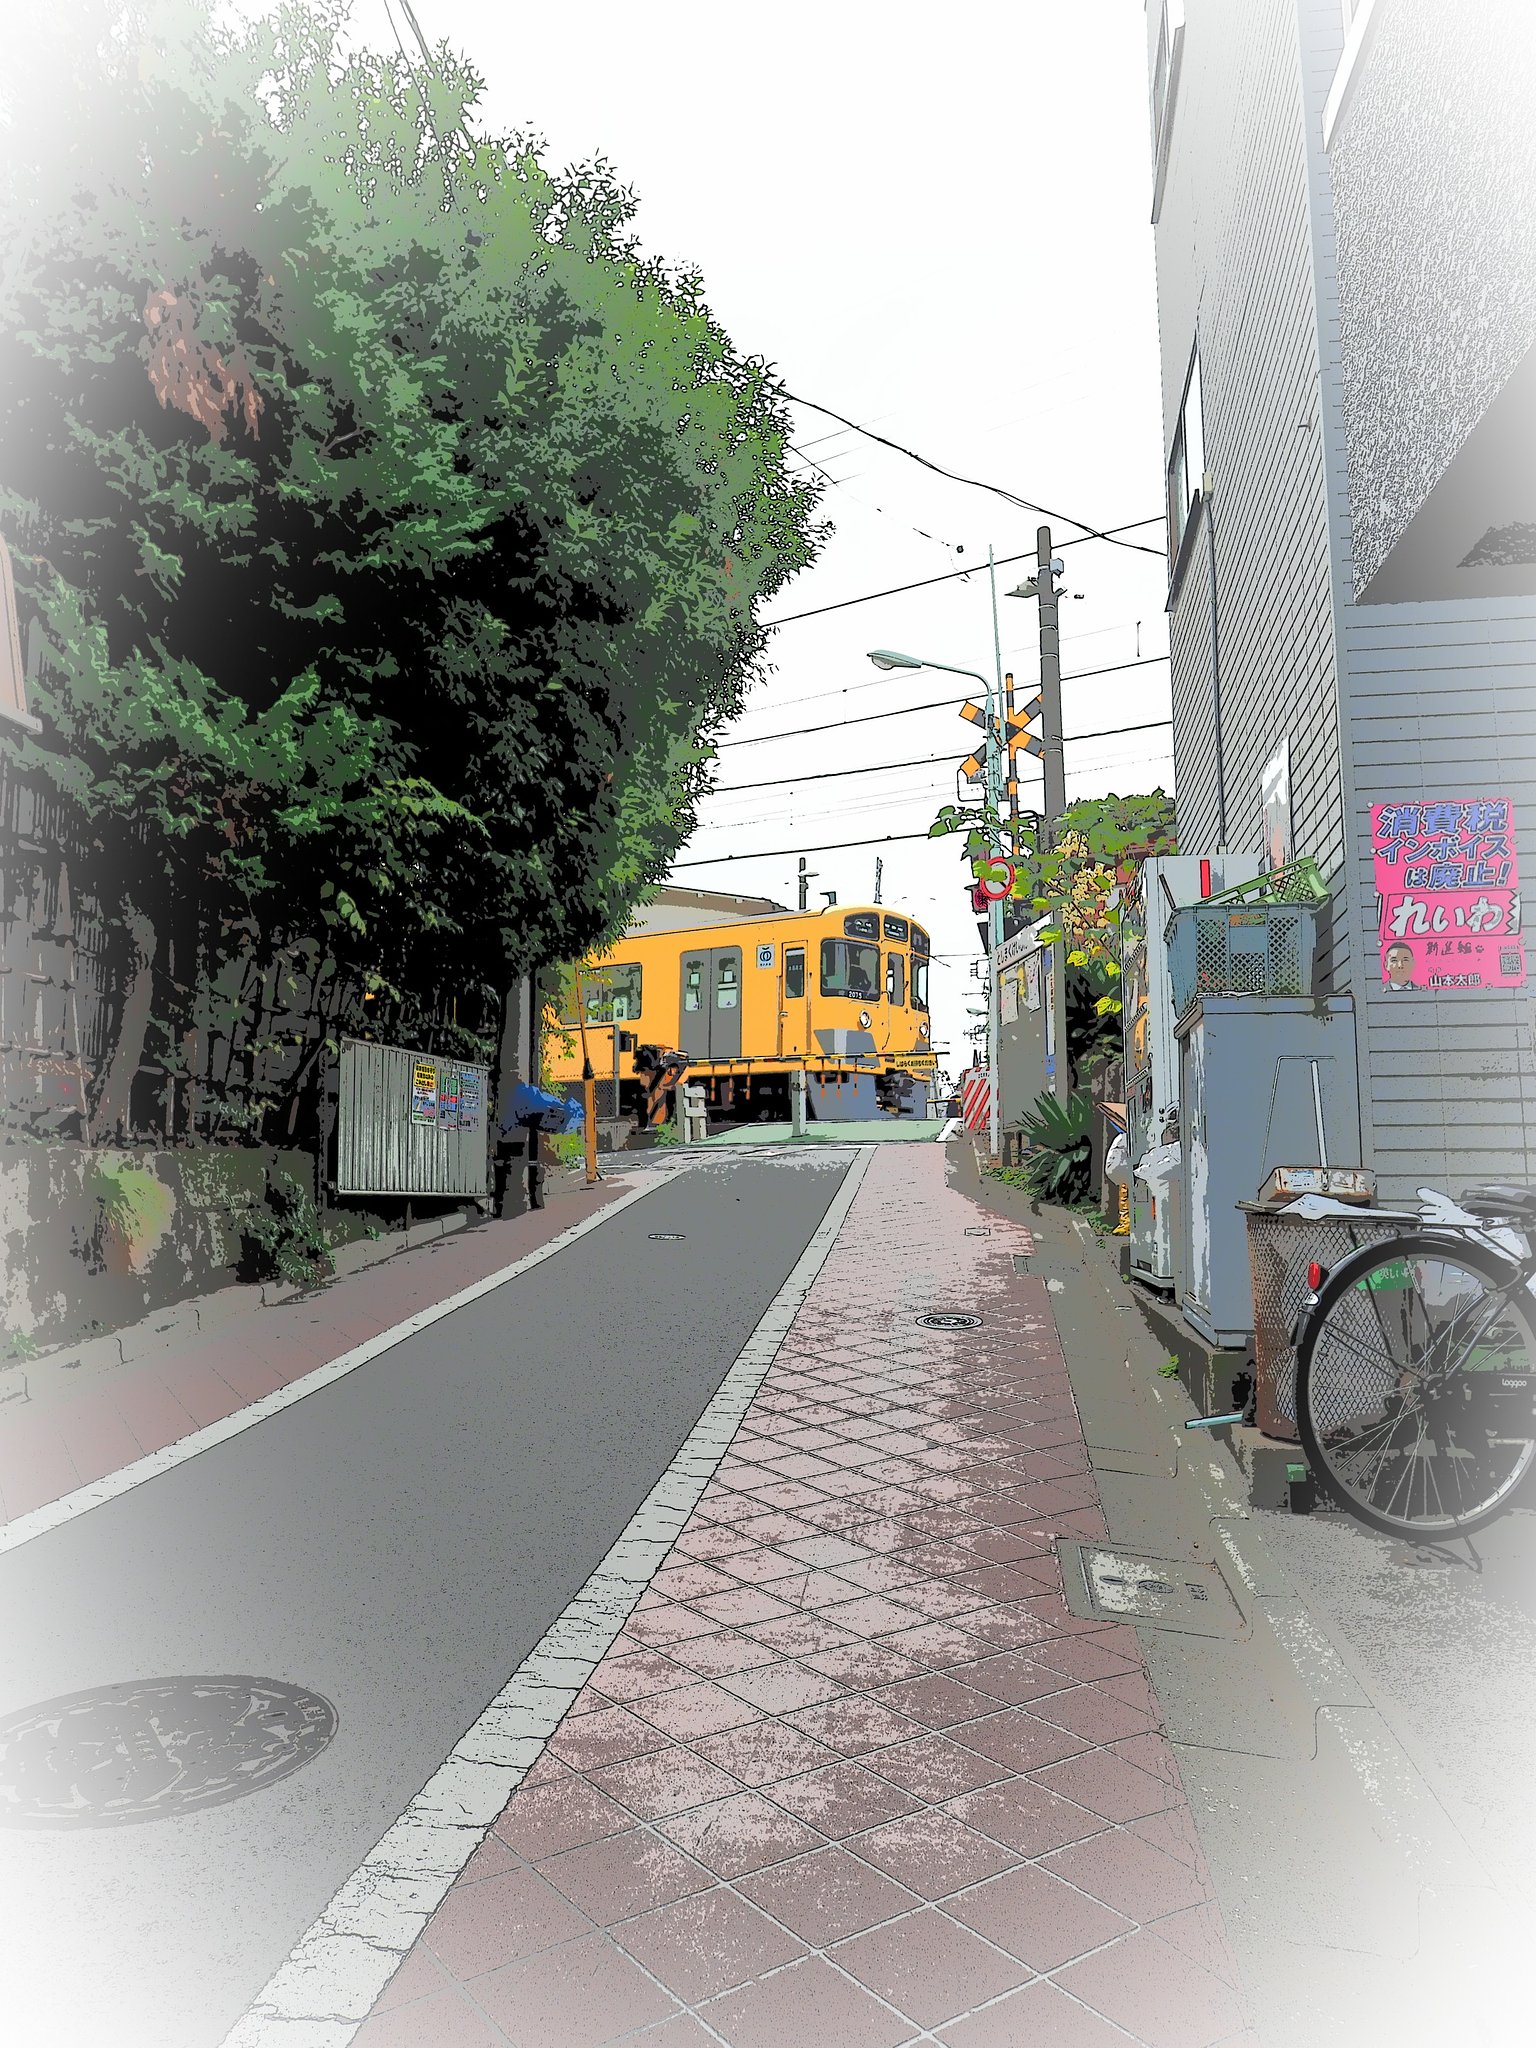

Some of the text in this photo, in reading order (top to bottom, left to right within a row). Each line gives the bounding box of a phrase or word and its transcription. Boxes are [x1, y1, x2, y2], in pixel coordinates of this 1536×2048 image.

[1379, 801, 1508, 837] 消費税
[1379, 834, 1511, 864] インボイス
[1405, 860, 1512, 889] は廃止!
[1389, 896, 1505, 937] れいわ
[1429, 974, 1481, 988] 山本太郎
